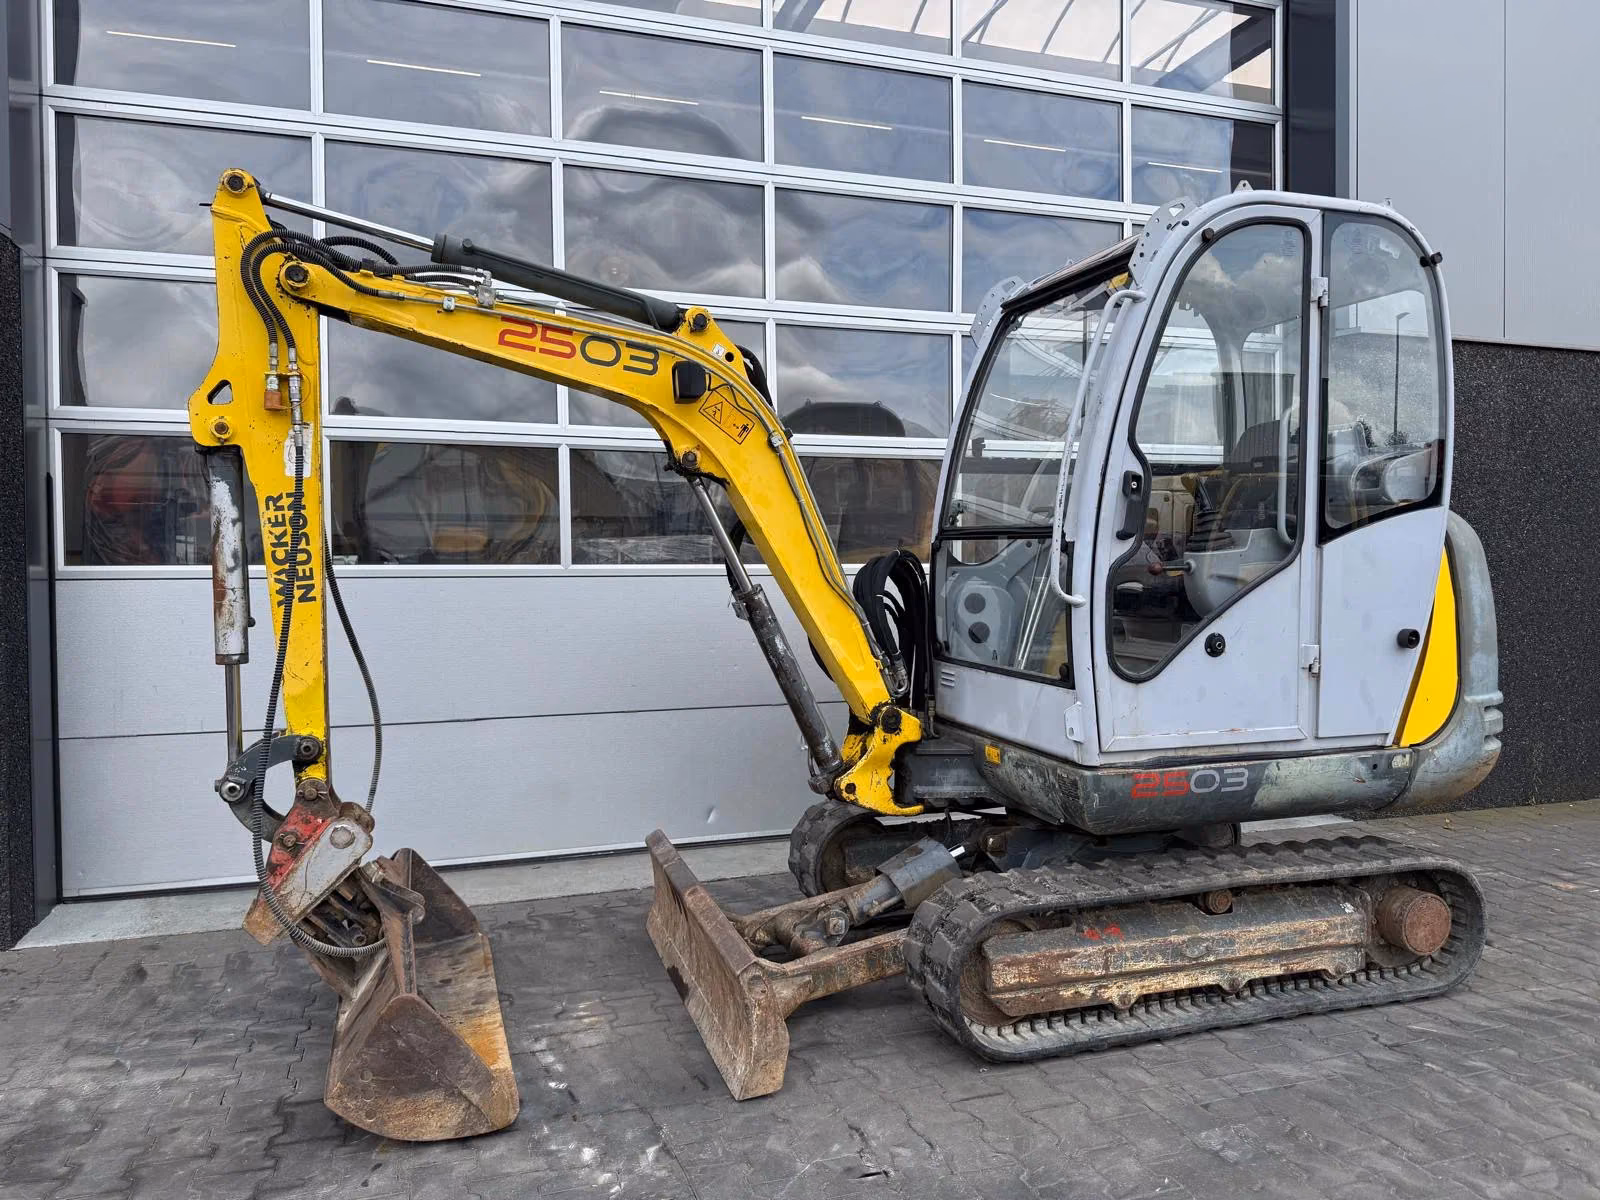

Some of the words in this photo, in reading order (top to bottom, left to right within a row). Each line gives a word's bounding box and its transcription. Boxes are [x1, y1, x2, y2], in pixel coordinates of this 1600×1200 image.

[498, 316, 660, 376] 2503
[264, 492, 295, 608] WACKER
[1131, 767, 1249, 798] 2503
